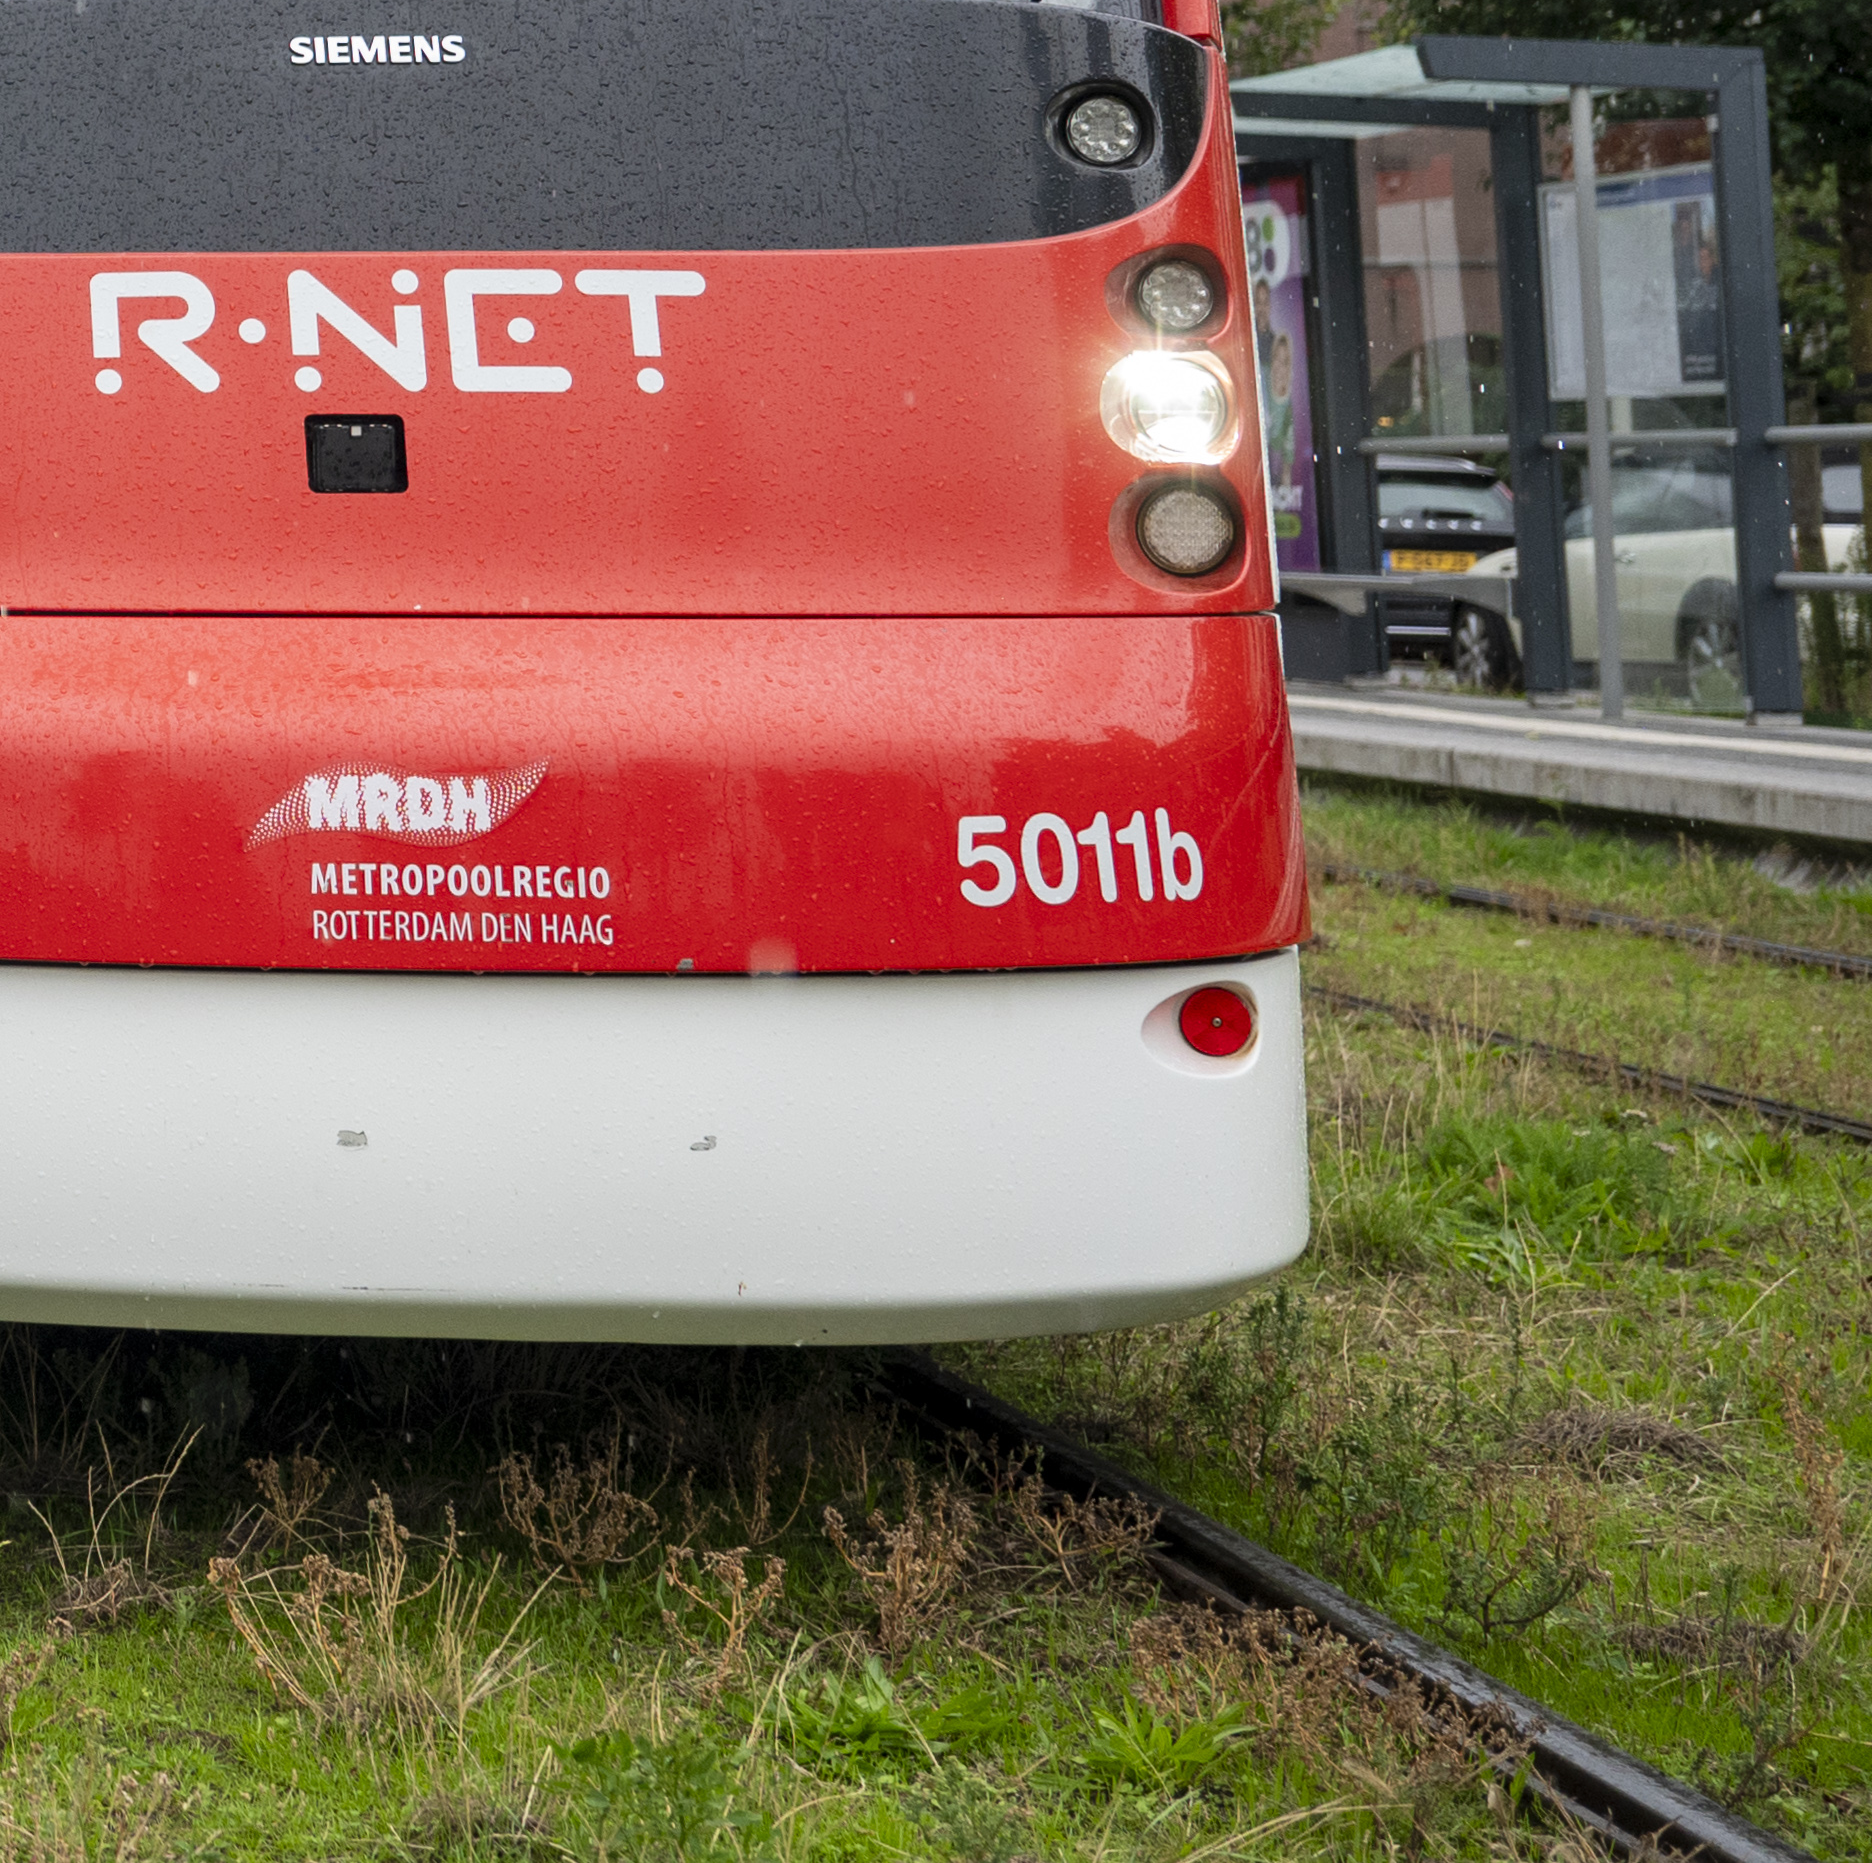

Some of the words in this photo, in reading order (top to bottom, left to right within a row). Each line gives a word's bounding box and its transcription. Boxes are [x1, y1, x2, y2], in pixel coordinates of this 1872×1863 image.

[289, 34, 466, 64] SIEMENS
[306, 772, 492, 833] MRDH
[958, 807, 1204, 908] 5011b
[310, 862, 611, 899] METROPOOLREGIO
[312, 909, 474, 942] ROTTERDAM
[481, 912, 532, 943] DEN
[540, 913, 614, 946] HAAG
